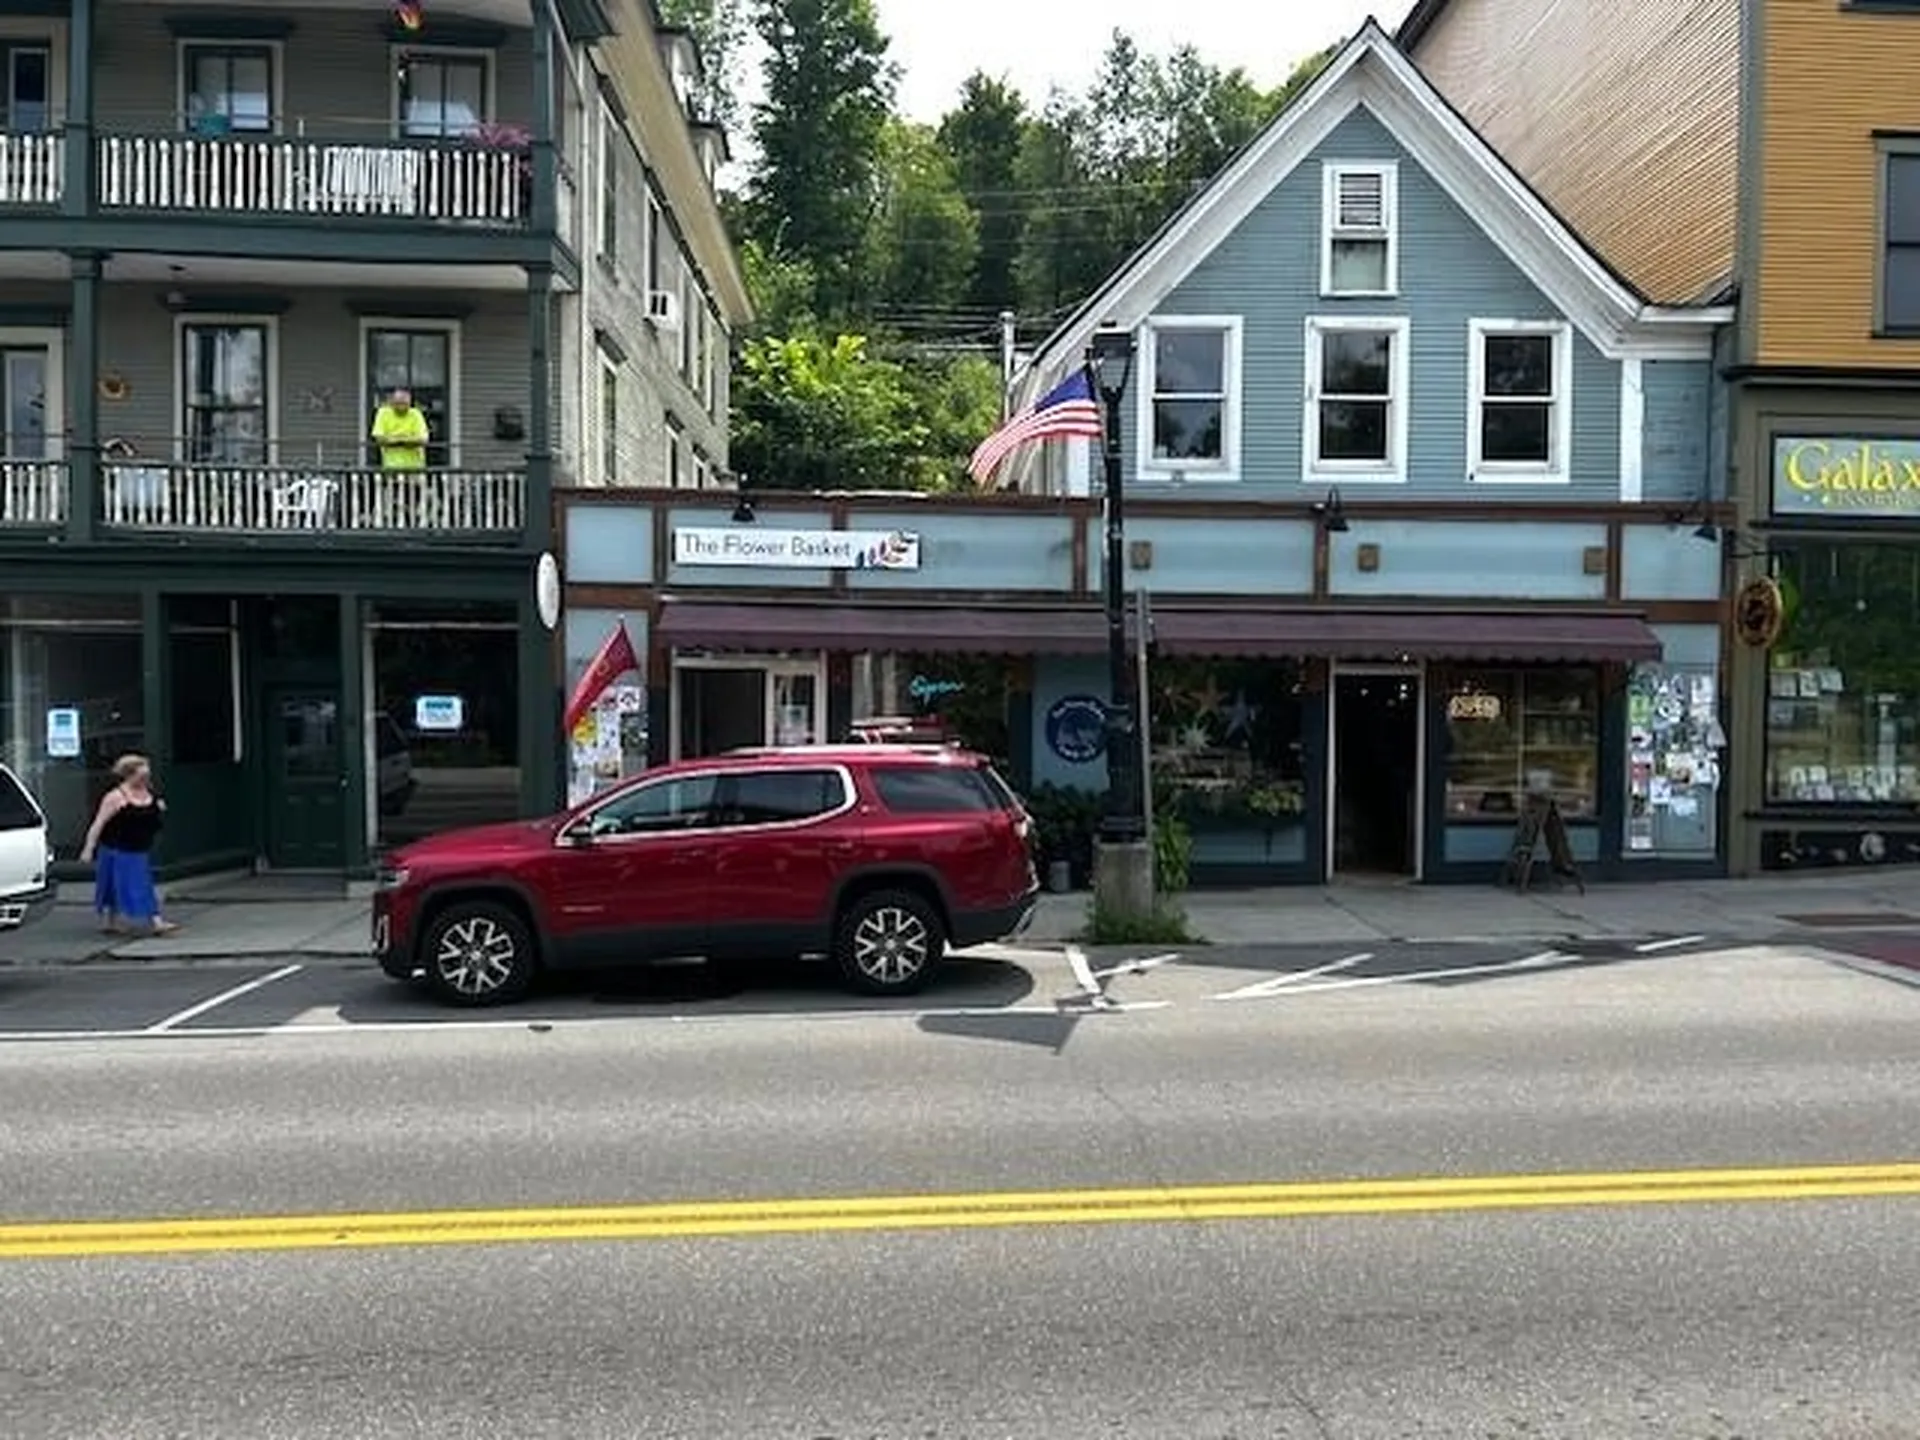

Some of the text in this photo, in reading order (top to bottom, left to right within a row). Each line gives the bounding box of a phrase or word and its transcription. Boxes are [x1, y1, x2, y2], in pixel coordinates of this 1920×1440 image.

[683, 533, 851, 557] The Flower Basket
